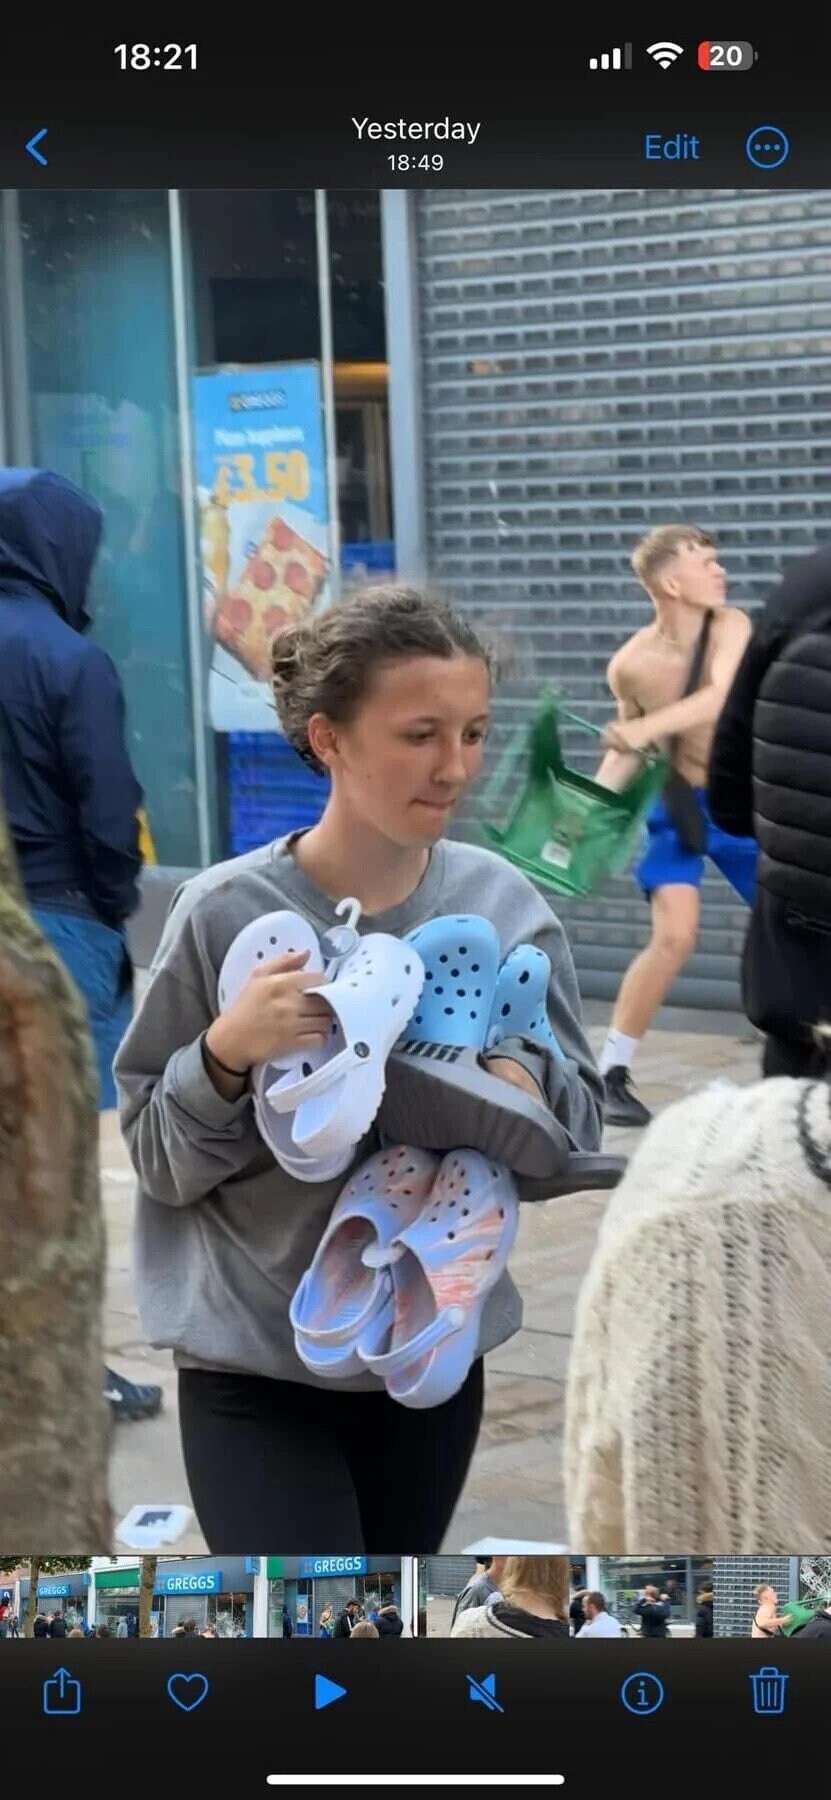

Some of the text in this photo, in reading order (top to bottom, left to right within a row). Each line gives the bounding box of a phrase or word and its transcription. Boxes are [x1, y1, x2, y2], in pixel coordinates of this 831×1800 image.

[313, 1556, 362, 1573] GREGGS
[167, 1575, 215, 1590] GREGGS
[39, 1586, 67, 1595] GREGGS
